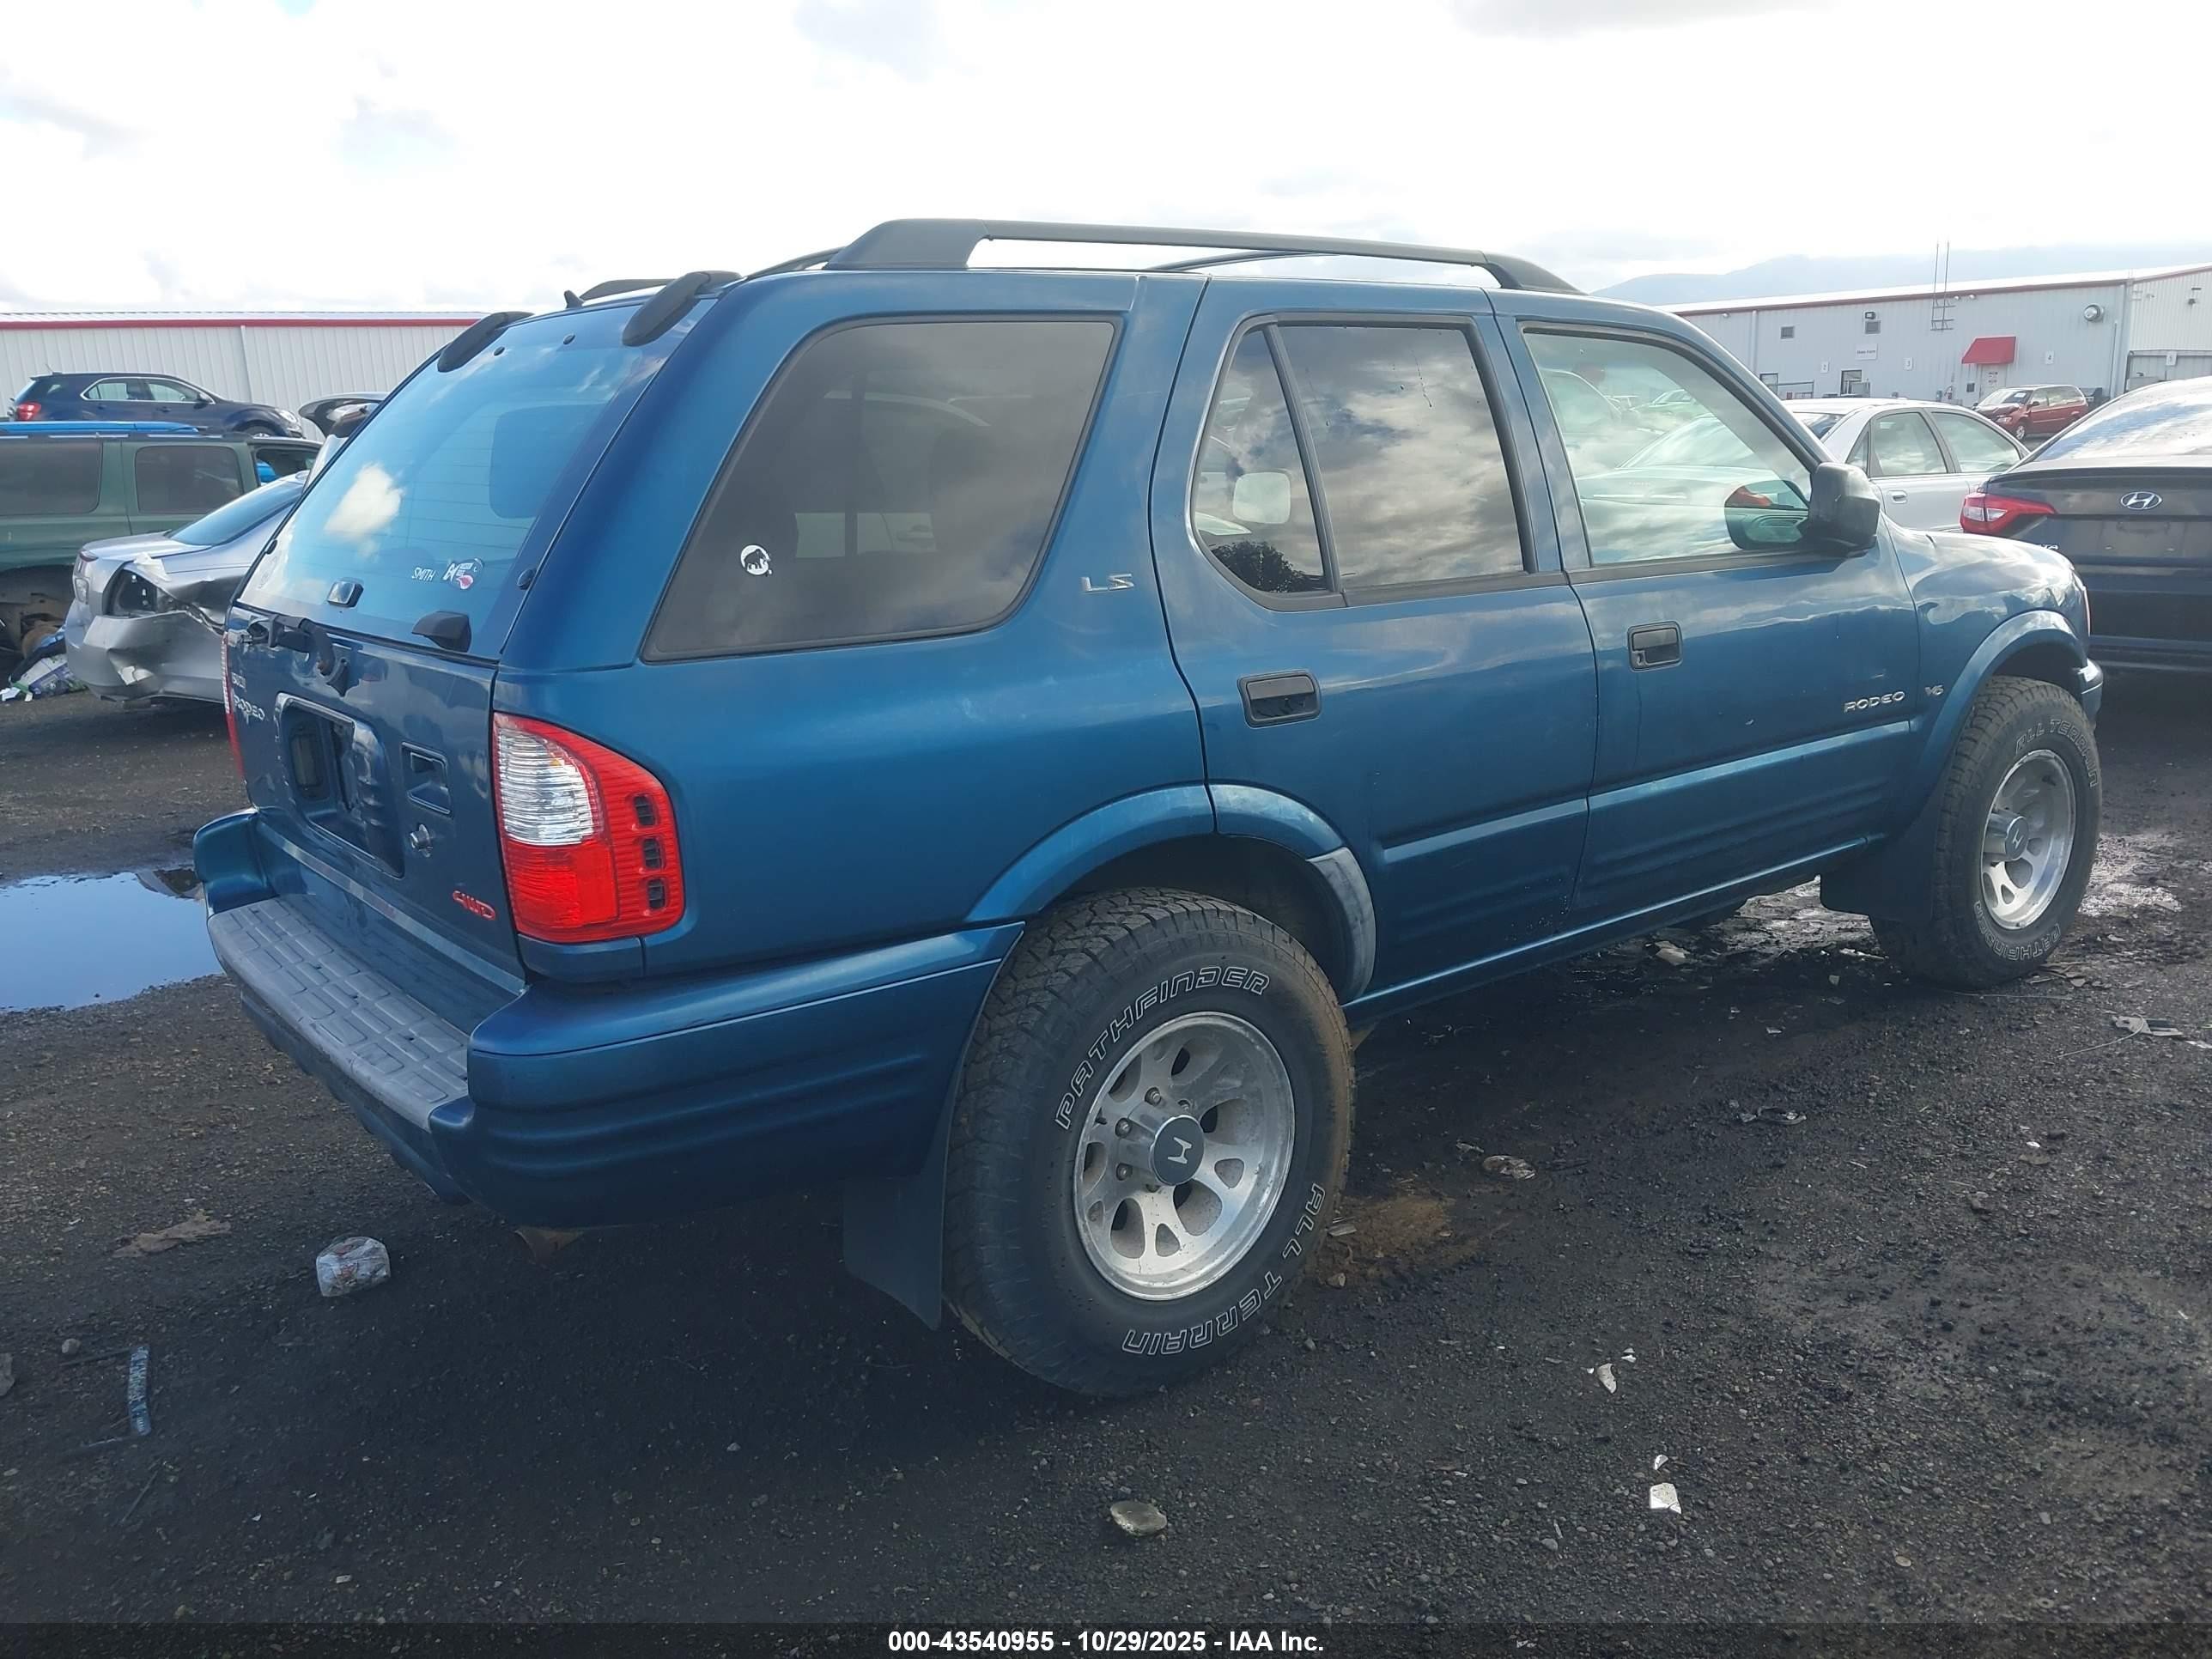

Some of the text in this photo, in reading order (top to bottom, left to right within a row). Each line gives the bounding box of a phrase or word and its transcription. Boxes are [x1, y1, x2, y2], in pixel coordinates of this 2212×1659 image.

[1080, 573, 1134, 593] LS
[1843, 690, 1906, 714] RODEO
[1054, 965, 1271, 1131] PATHFINDER
[1121, 1182, 1327, 1357] ALL TERRAIN
